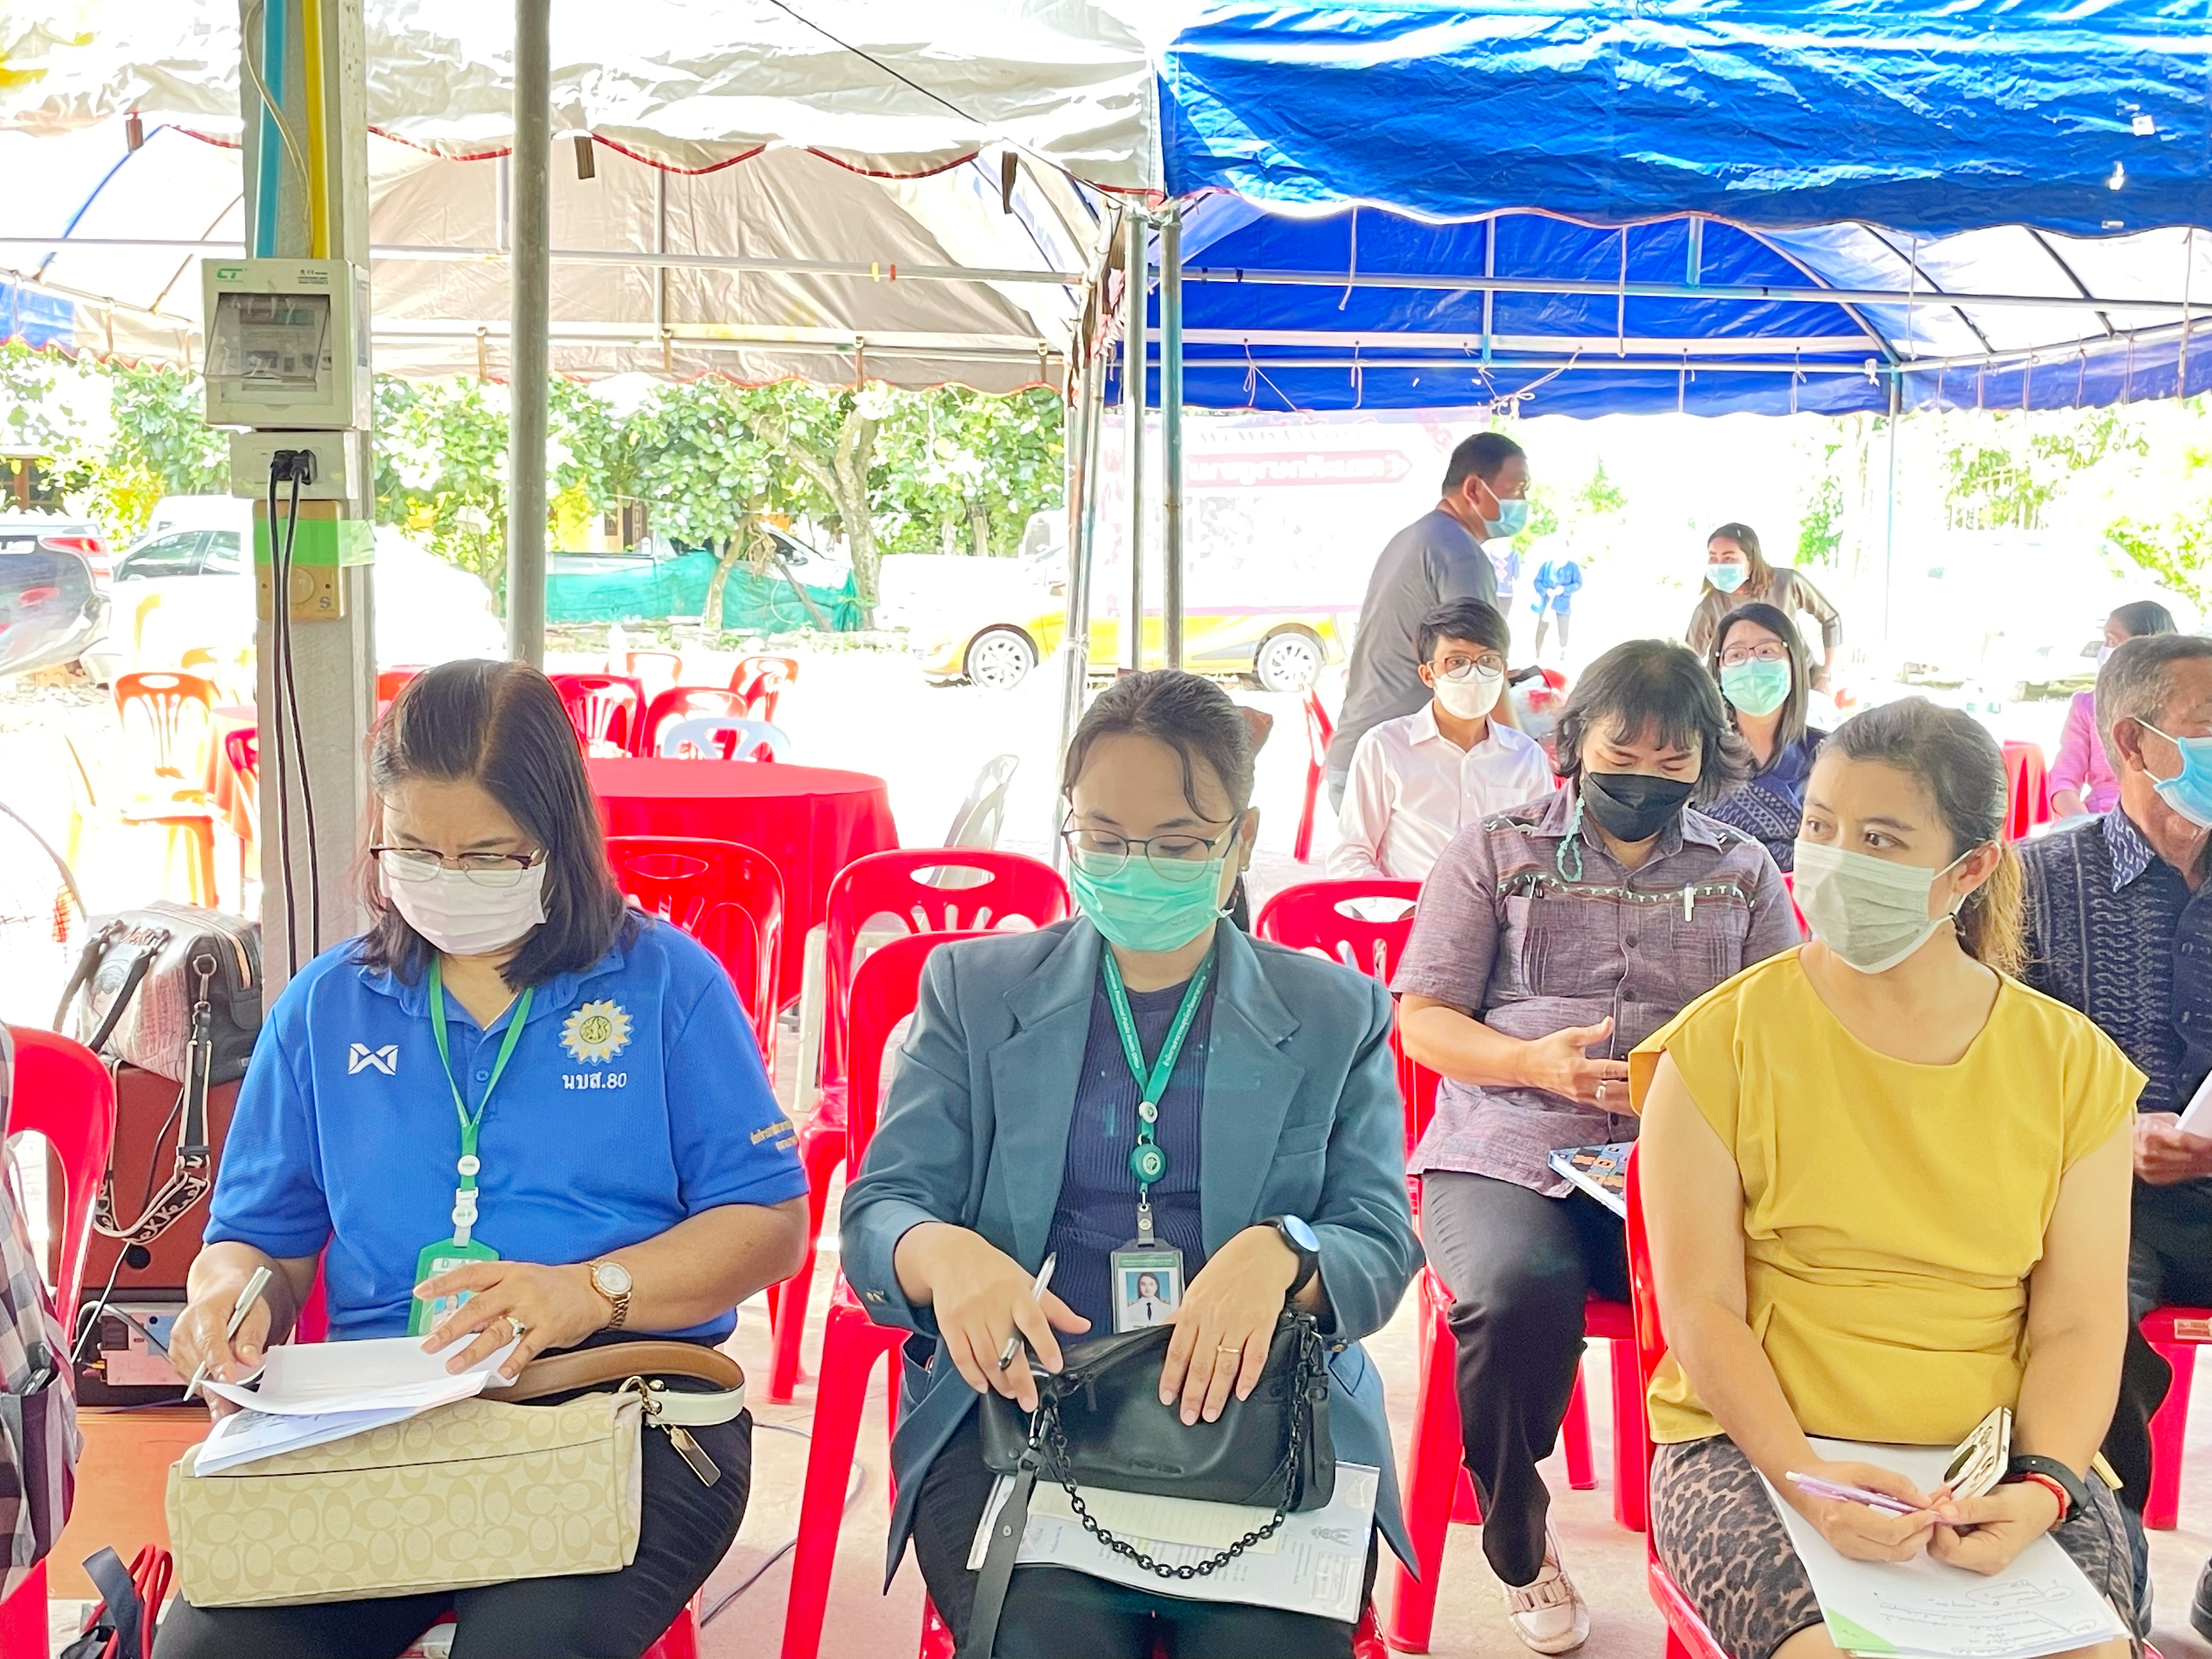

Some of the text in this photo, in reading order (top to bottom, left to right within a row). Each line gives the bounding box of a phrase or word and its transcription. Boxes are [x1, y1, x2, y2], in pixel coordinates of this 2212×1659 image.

[217, 268, 243, 279] CT
[319, 596, 331, 608] S
[562, 1071, 628, 1090] นบส.80
